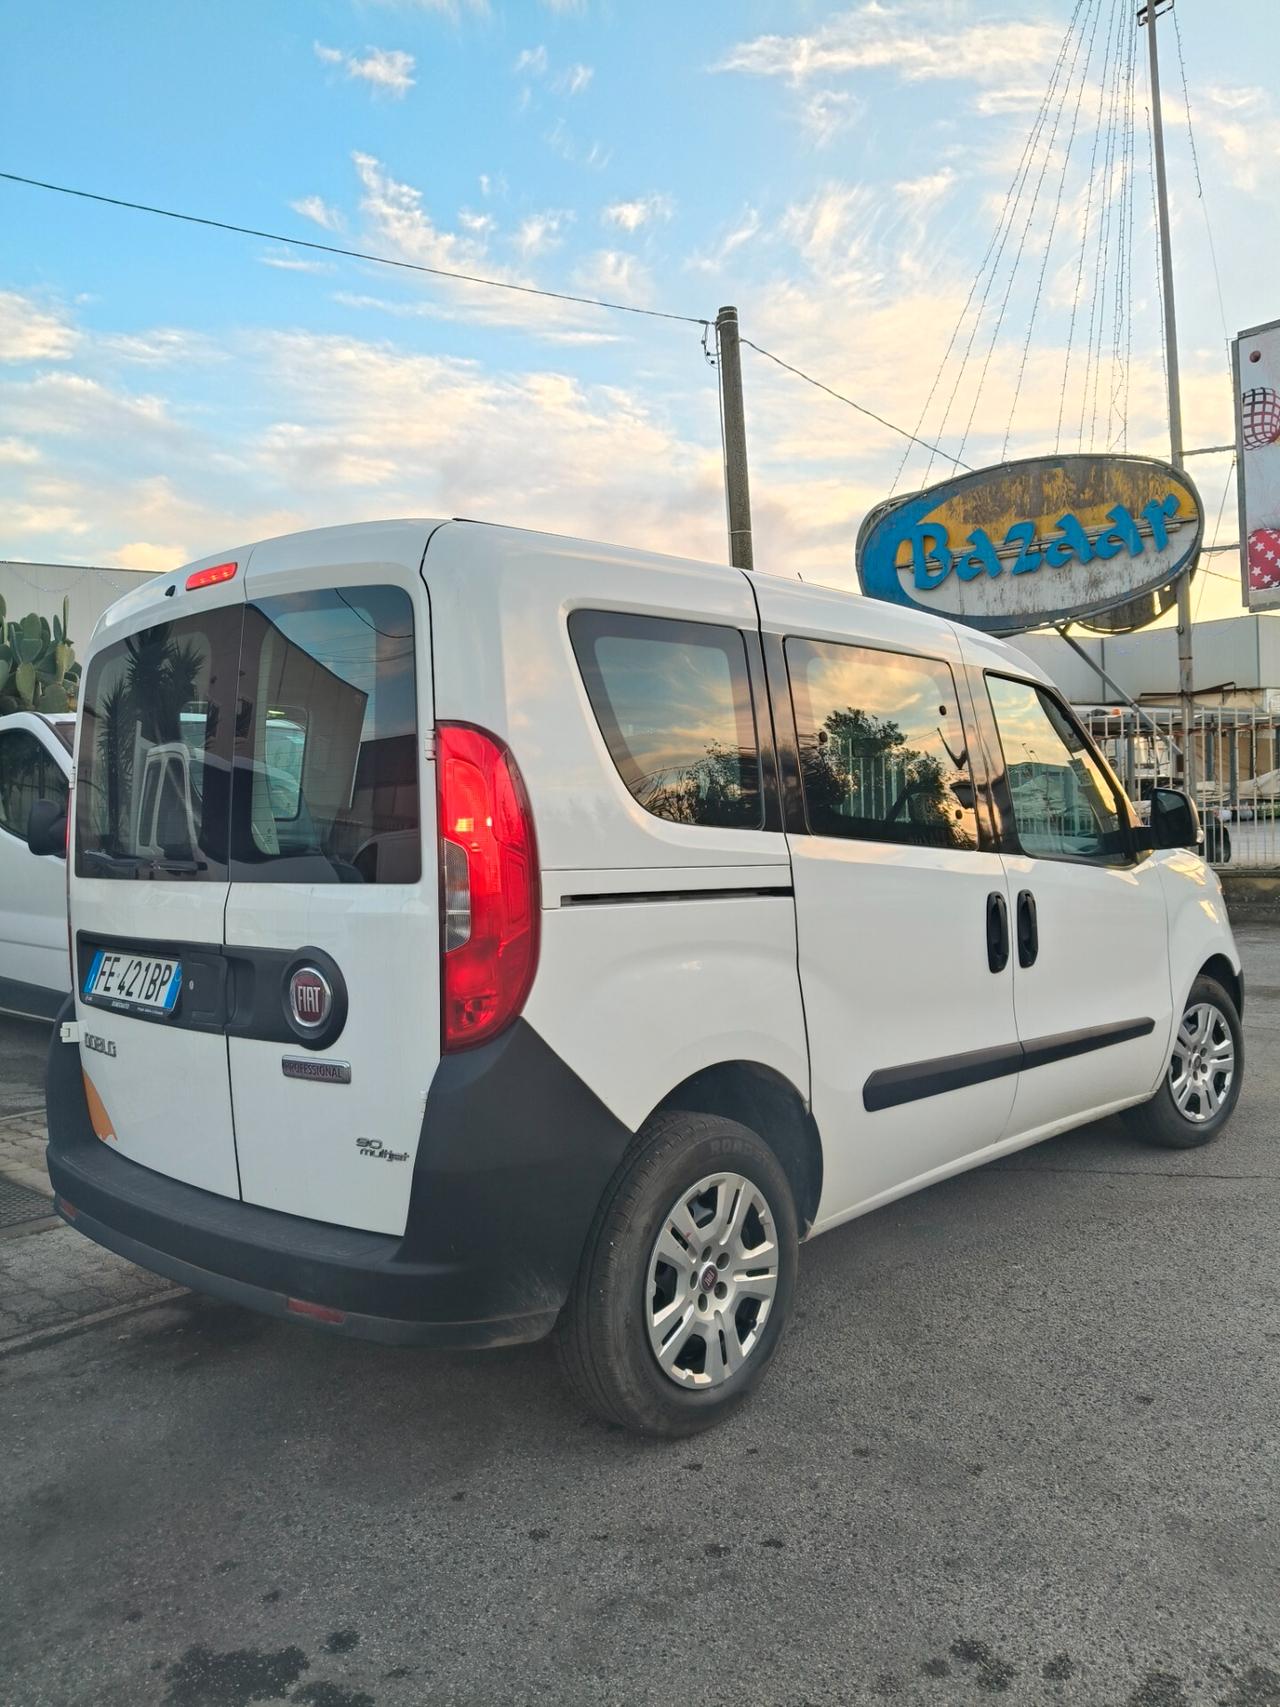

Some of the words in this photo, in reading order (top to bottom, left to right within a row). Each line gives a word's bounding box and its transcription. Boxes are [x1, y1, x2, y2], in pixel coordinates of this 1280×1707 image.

[899, 493, 1181, 590] Bazaar
[95, 956, 120, 992] FE
[117, 960, 172, 1002] 421BP
[296, 985, 320, 1013] FIAT
[285, 1061, 342, 1079] PROFESSIONAL
[356, 1137, 383, 1150] 90
